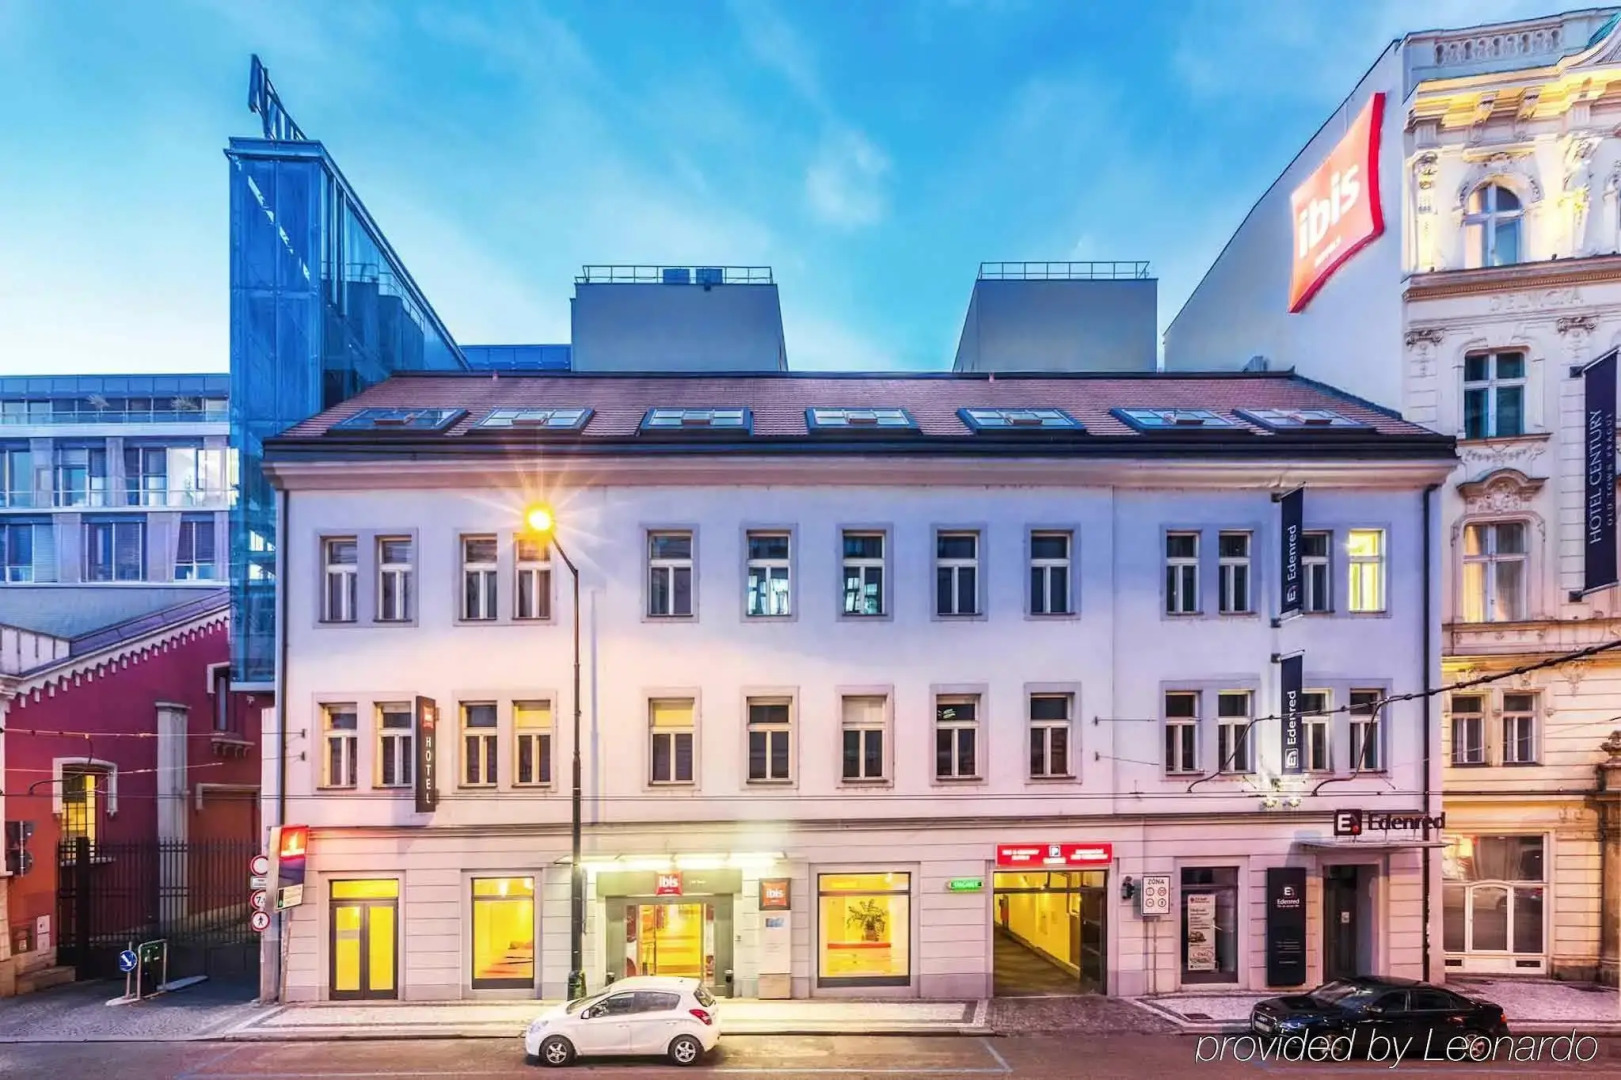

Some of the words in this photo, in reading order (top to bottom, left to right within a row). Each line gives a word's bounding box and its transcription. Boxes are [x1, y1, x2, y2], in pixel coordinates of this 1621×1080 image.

[1299, 164, 1360, 259] ibis
[1589, 409, 1602, 486] CENTURY
[1589, 487, 1602, 544] HOTEL
[1287, 524, 1297, 582] Edenred
[1287, 690, 1297, 745] Edenred
[1368, 811, 1446, 831] Edenred
[659, 874, 679, 888] ibis
[766, 888, 784, 898] ibis
